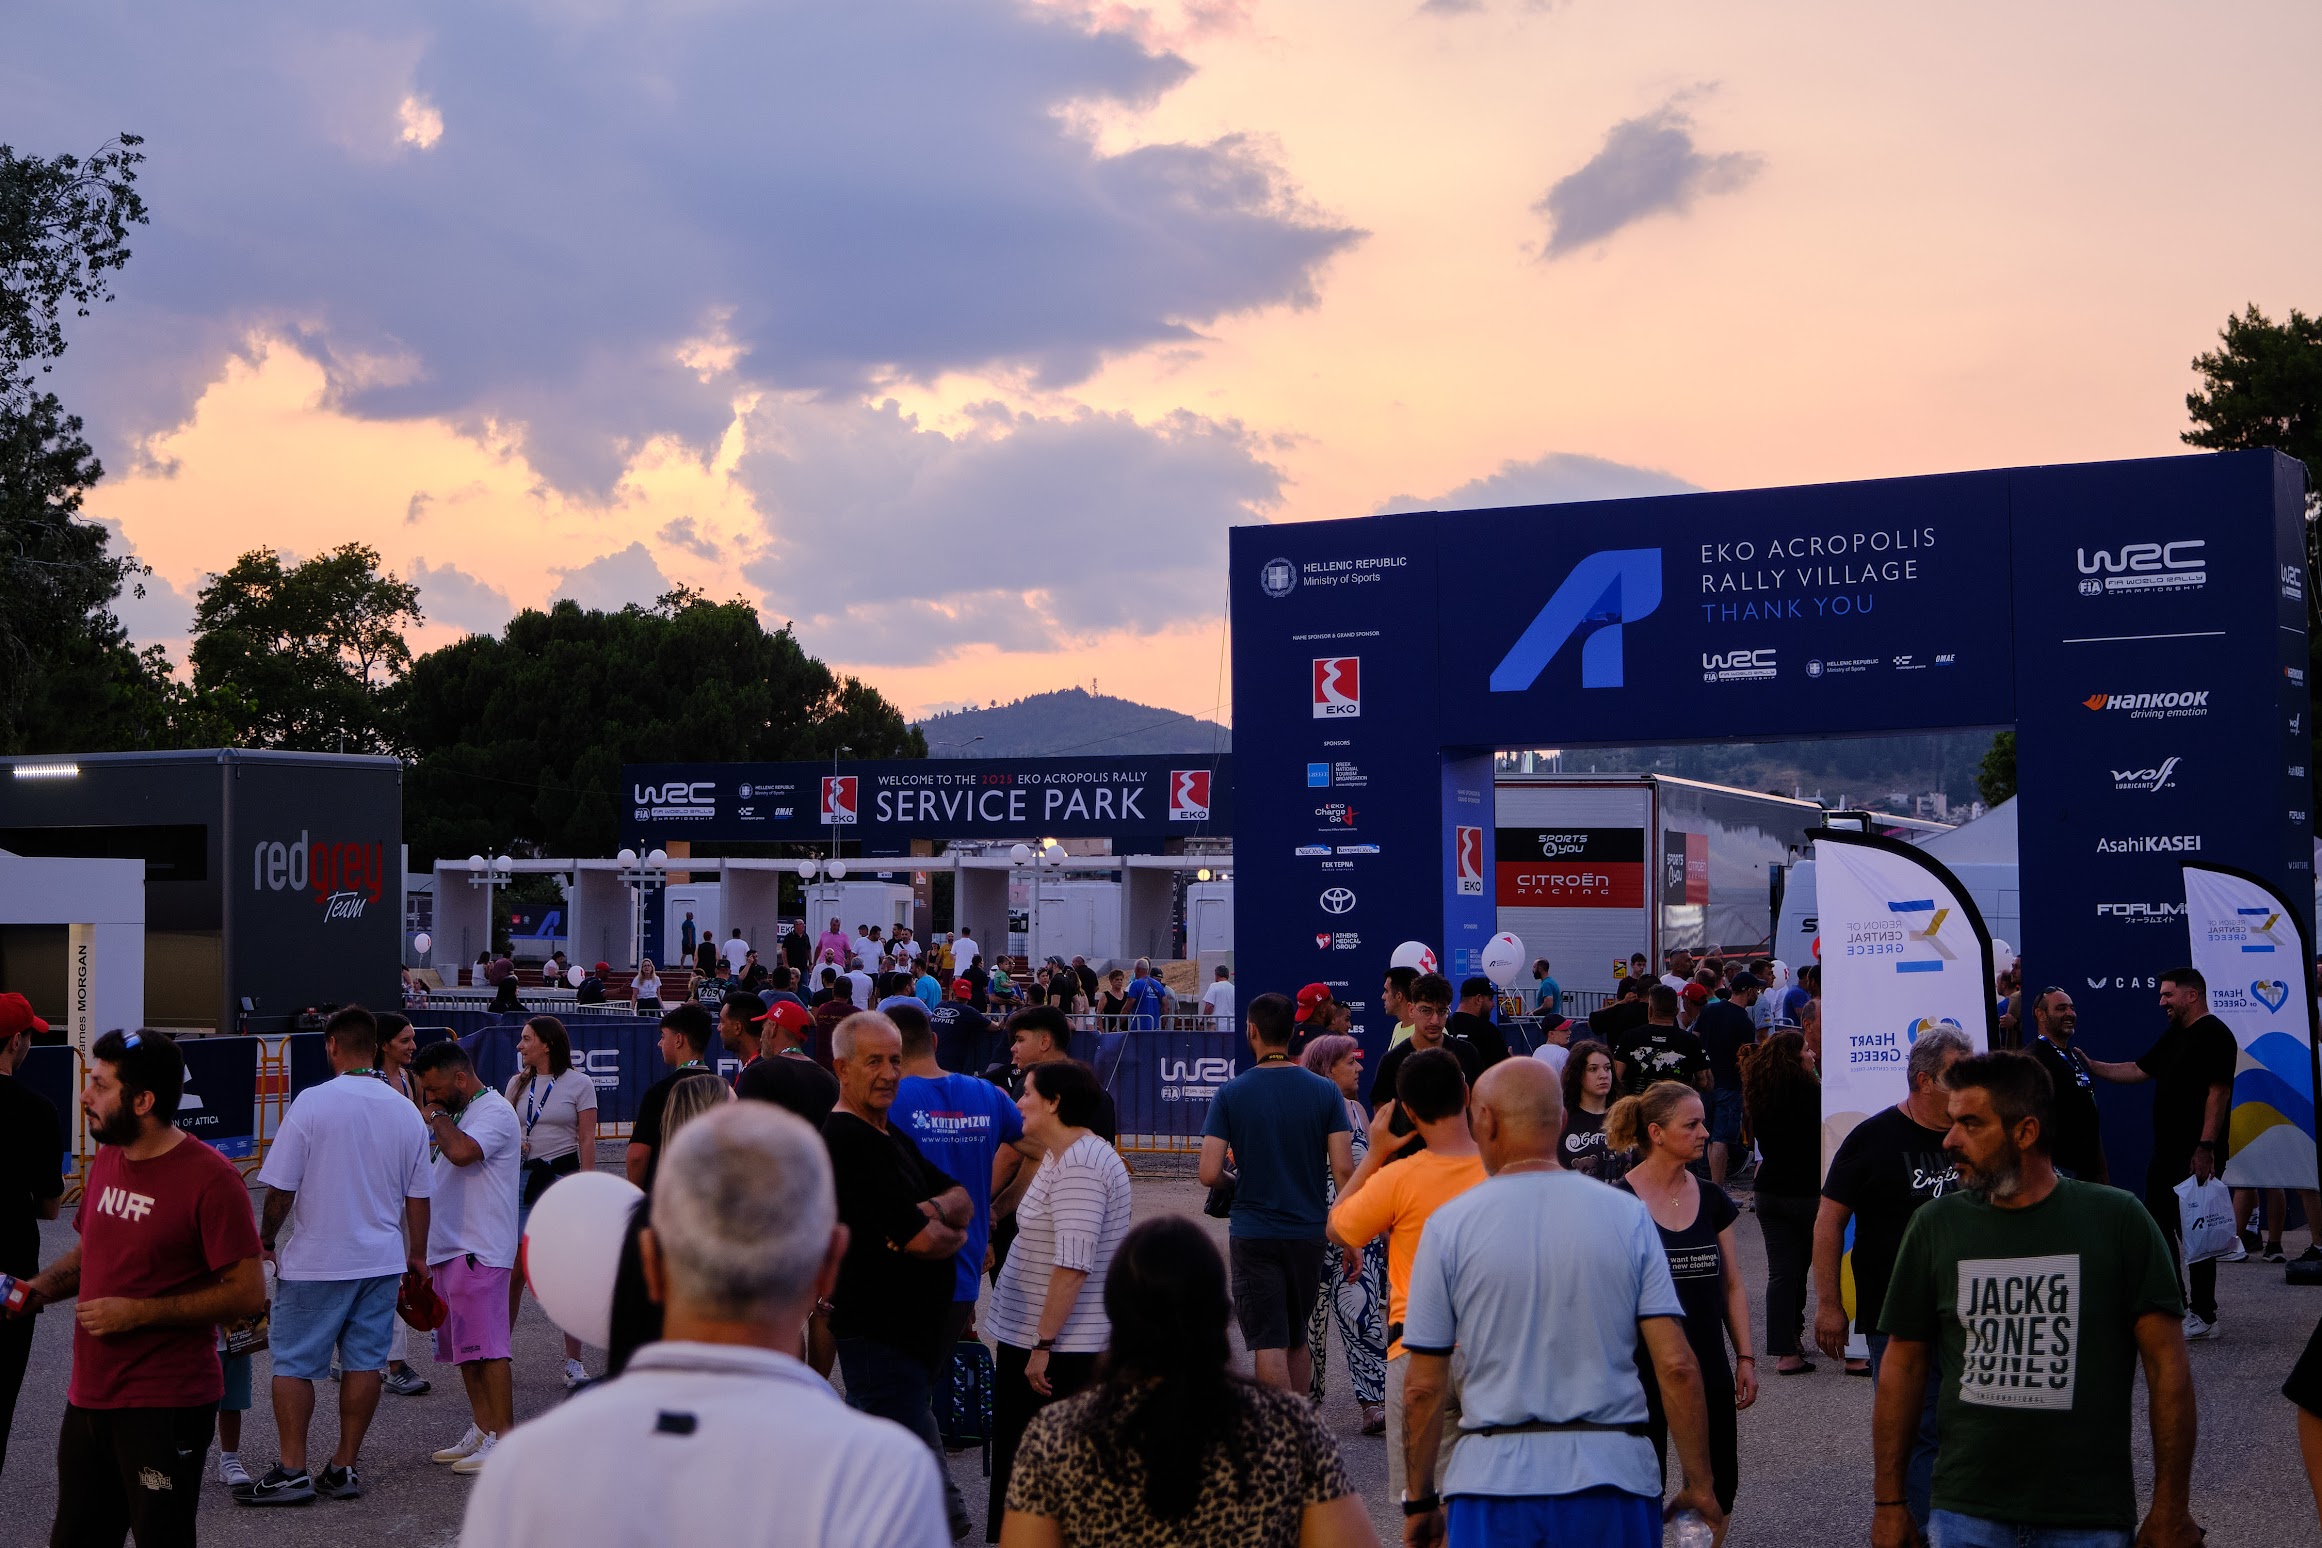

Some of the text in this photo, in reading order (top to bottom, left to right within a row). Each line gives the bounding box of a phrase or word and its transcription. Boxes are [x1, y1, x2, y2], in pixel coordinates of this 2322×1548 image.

[1701, 527, 1936, 563] EKO ACROPOLIS
[2077, 539, 2206, 574] WRC
[1303, 556, 1407, 573] HELLENIC REPUBLIC
[1303, 572, 1381, 587] Ministry of Sports
[1701, 559, 1919, 594] RALLY VILLAGE
[2126, 577, 2163, 585] WORLD
[2166, 575, 2203, 583] RALLY
[2108, 584, 2204, 595] CHAMPIONSHIP
[1701, 594, 1874, 623] THANK YOU
[1702, 648, 1777, 669] WRC
[1703, 673, 1717, 682] FIA
[1326, 704, 1357, 714] EKO
[2130, 707, 2208, 720] driving emotion
[878, 771, 1148, 786] WELCOME TO THE 2025 EKO ACROPOLIS RALLY
[2115, 781, 2154, 790] LUBRICANTS
[634, 782, 716, 805] WRC
[876, 787, 1146, 822] SERVICE PARK
[635, 810, 649, 820] FIA
[1180, 811, 1206, 819] EKO
[1315, 808, 1346, 816] Charge
[831, 815, 855, 823] EKO
[1329, 815, 1342, 823] Go
[1538, 834, 1588, 843] SPORTS
[1334, 860, 1354, 868] ΤΕΡΝΑ
[1666, 852, 1684, 866] SPORTS
[254, 829, 383, 905] redgrey
[1464, 881, 1481, 892] EKO
[323, 890, 367, 923] Team
[1801, 918, 1818, 933] S
[2124, 915, 2175, 924] フォーラムエイト
[77, 945, 87, 1012] MORGAN
[2115, 977, 2156, 988] CAS
[182, 1117, 194, 1127] OF
[195, 1115, 219, 1126] ATTICA
[97, 1185, 155, 1223] NUFF
[1690, 1261, 1717, 1269] clothes.
[1968, 1315, 2071, 1357] JONES
